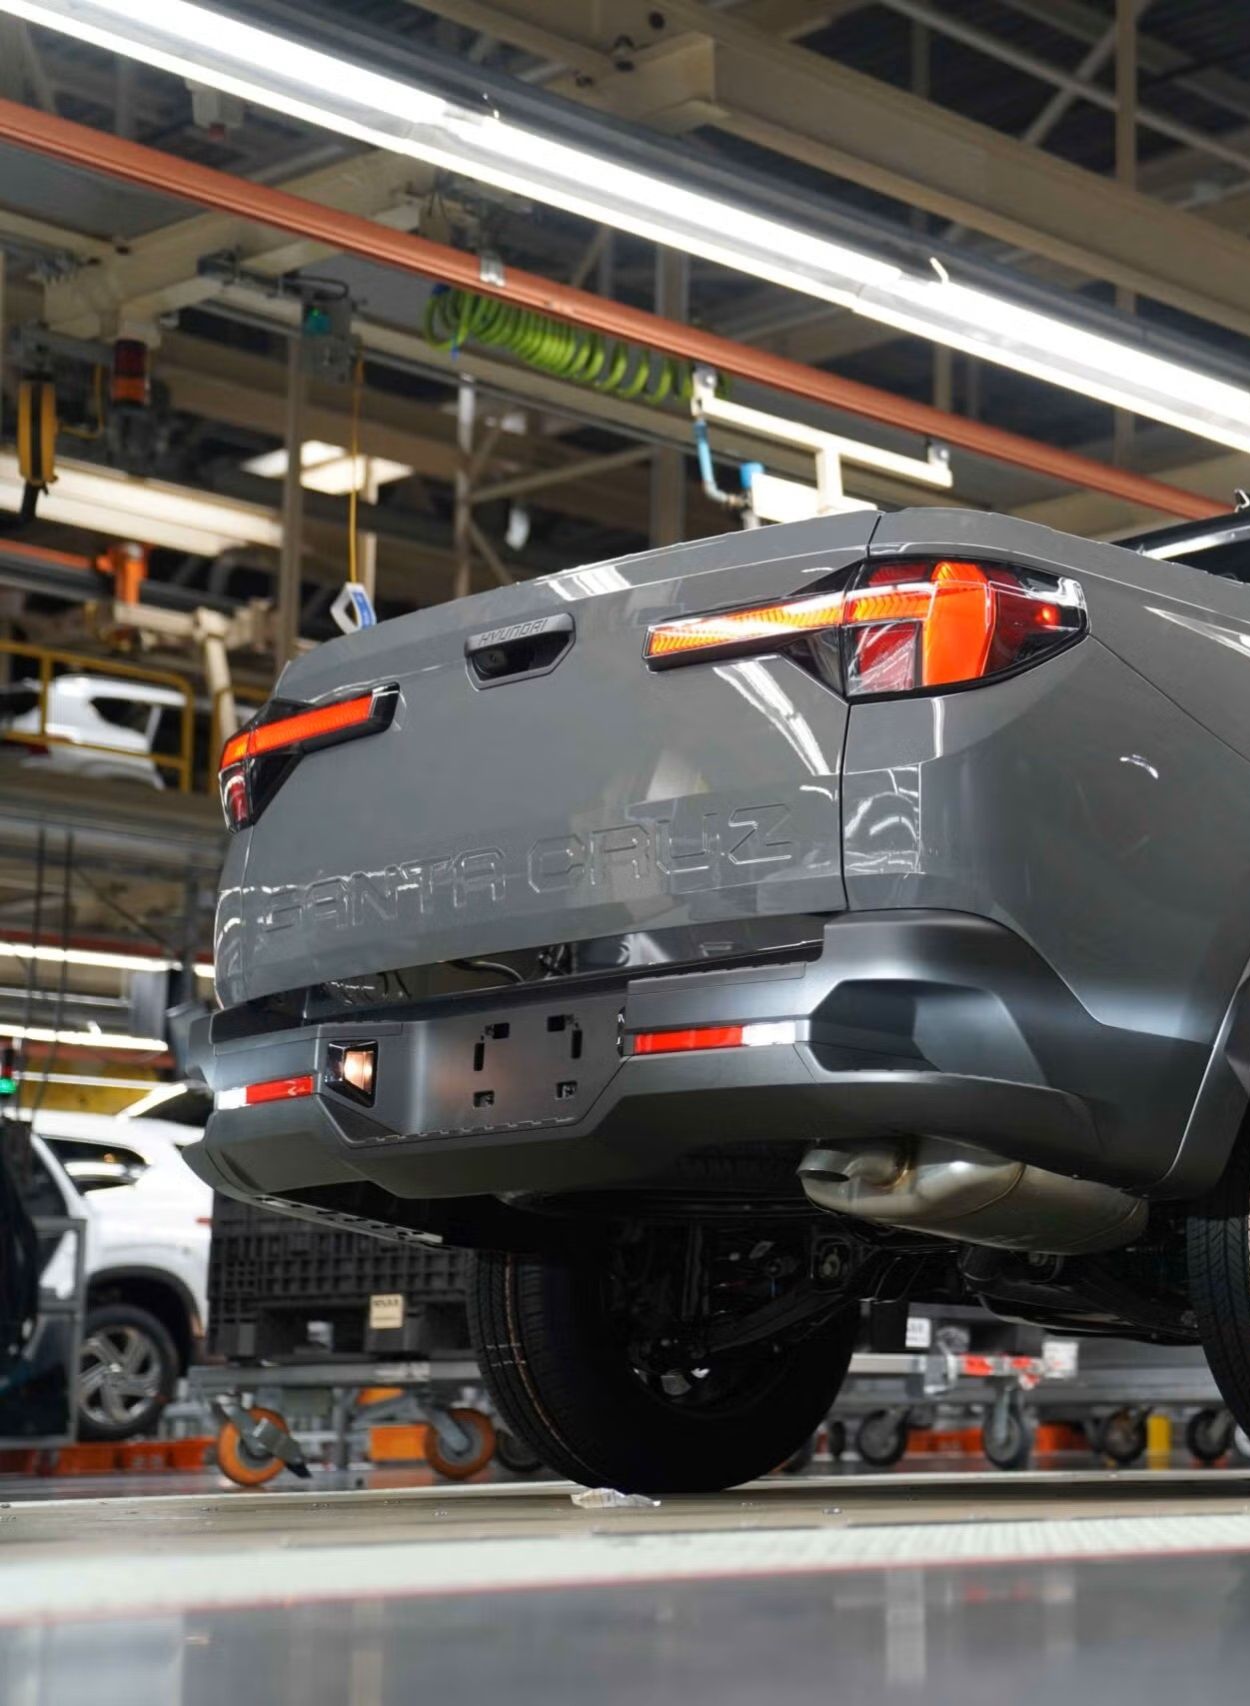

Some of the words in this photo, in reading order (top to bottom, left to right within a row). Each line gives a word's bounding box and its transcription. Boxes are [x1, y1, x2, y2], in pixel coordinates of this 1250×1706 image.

[479, 618, 548, 646] HYUNDAI
[257, 847, 506, 933] SANTA
[528, 803, 792, 893] CRUZ
